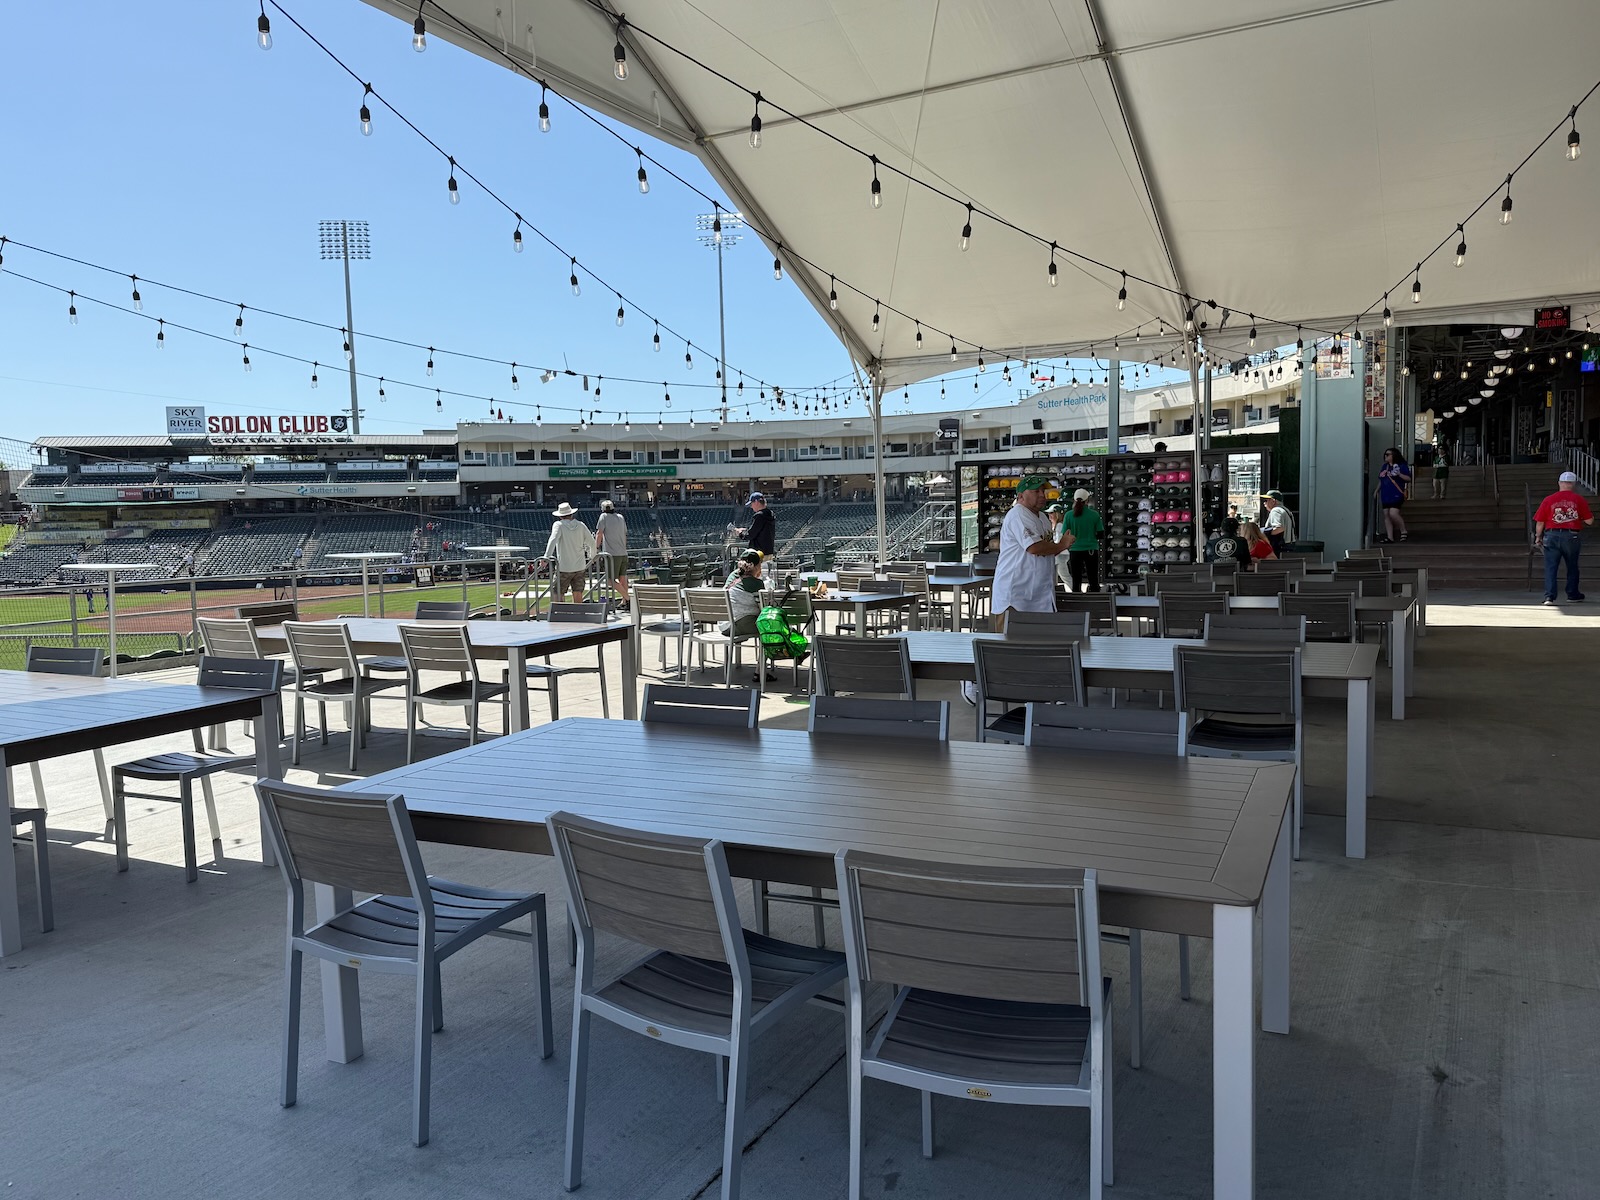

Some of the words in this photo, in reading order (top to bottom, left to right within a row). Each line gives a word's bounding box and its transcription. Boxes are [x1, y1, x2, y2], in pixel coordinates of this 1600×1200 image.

[1541, 311, 1551, 319] NO
[1538, 318, 1567, 328] SMOKING
[1037, 400, 1062, 409] Sutter
[1063, 396, 1088, 406] Health
[1089, 393, 1107, 403] Park
[174, 408, 196, 417] SKY
[170, 419, 202, 427] RIVER
[208, 416, 272, 433] SOLON
[278, 416, 329, 433] CLUB
[310, 486, 332, 494] Sutter
[333, 486, 356, 494] Health
